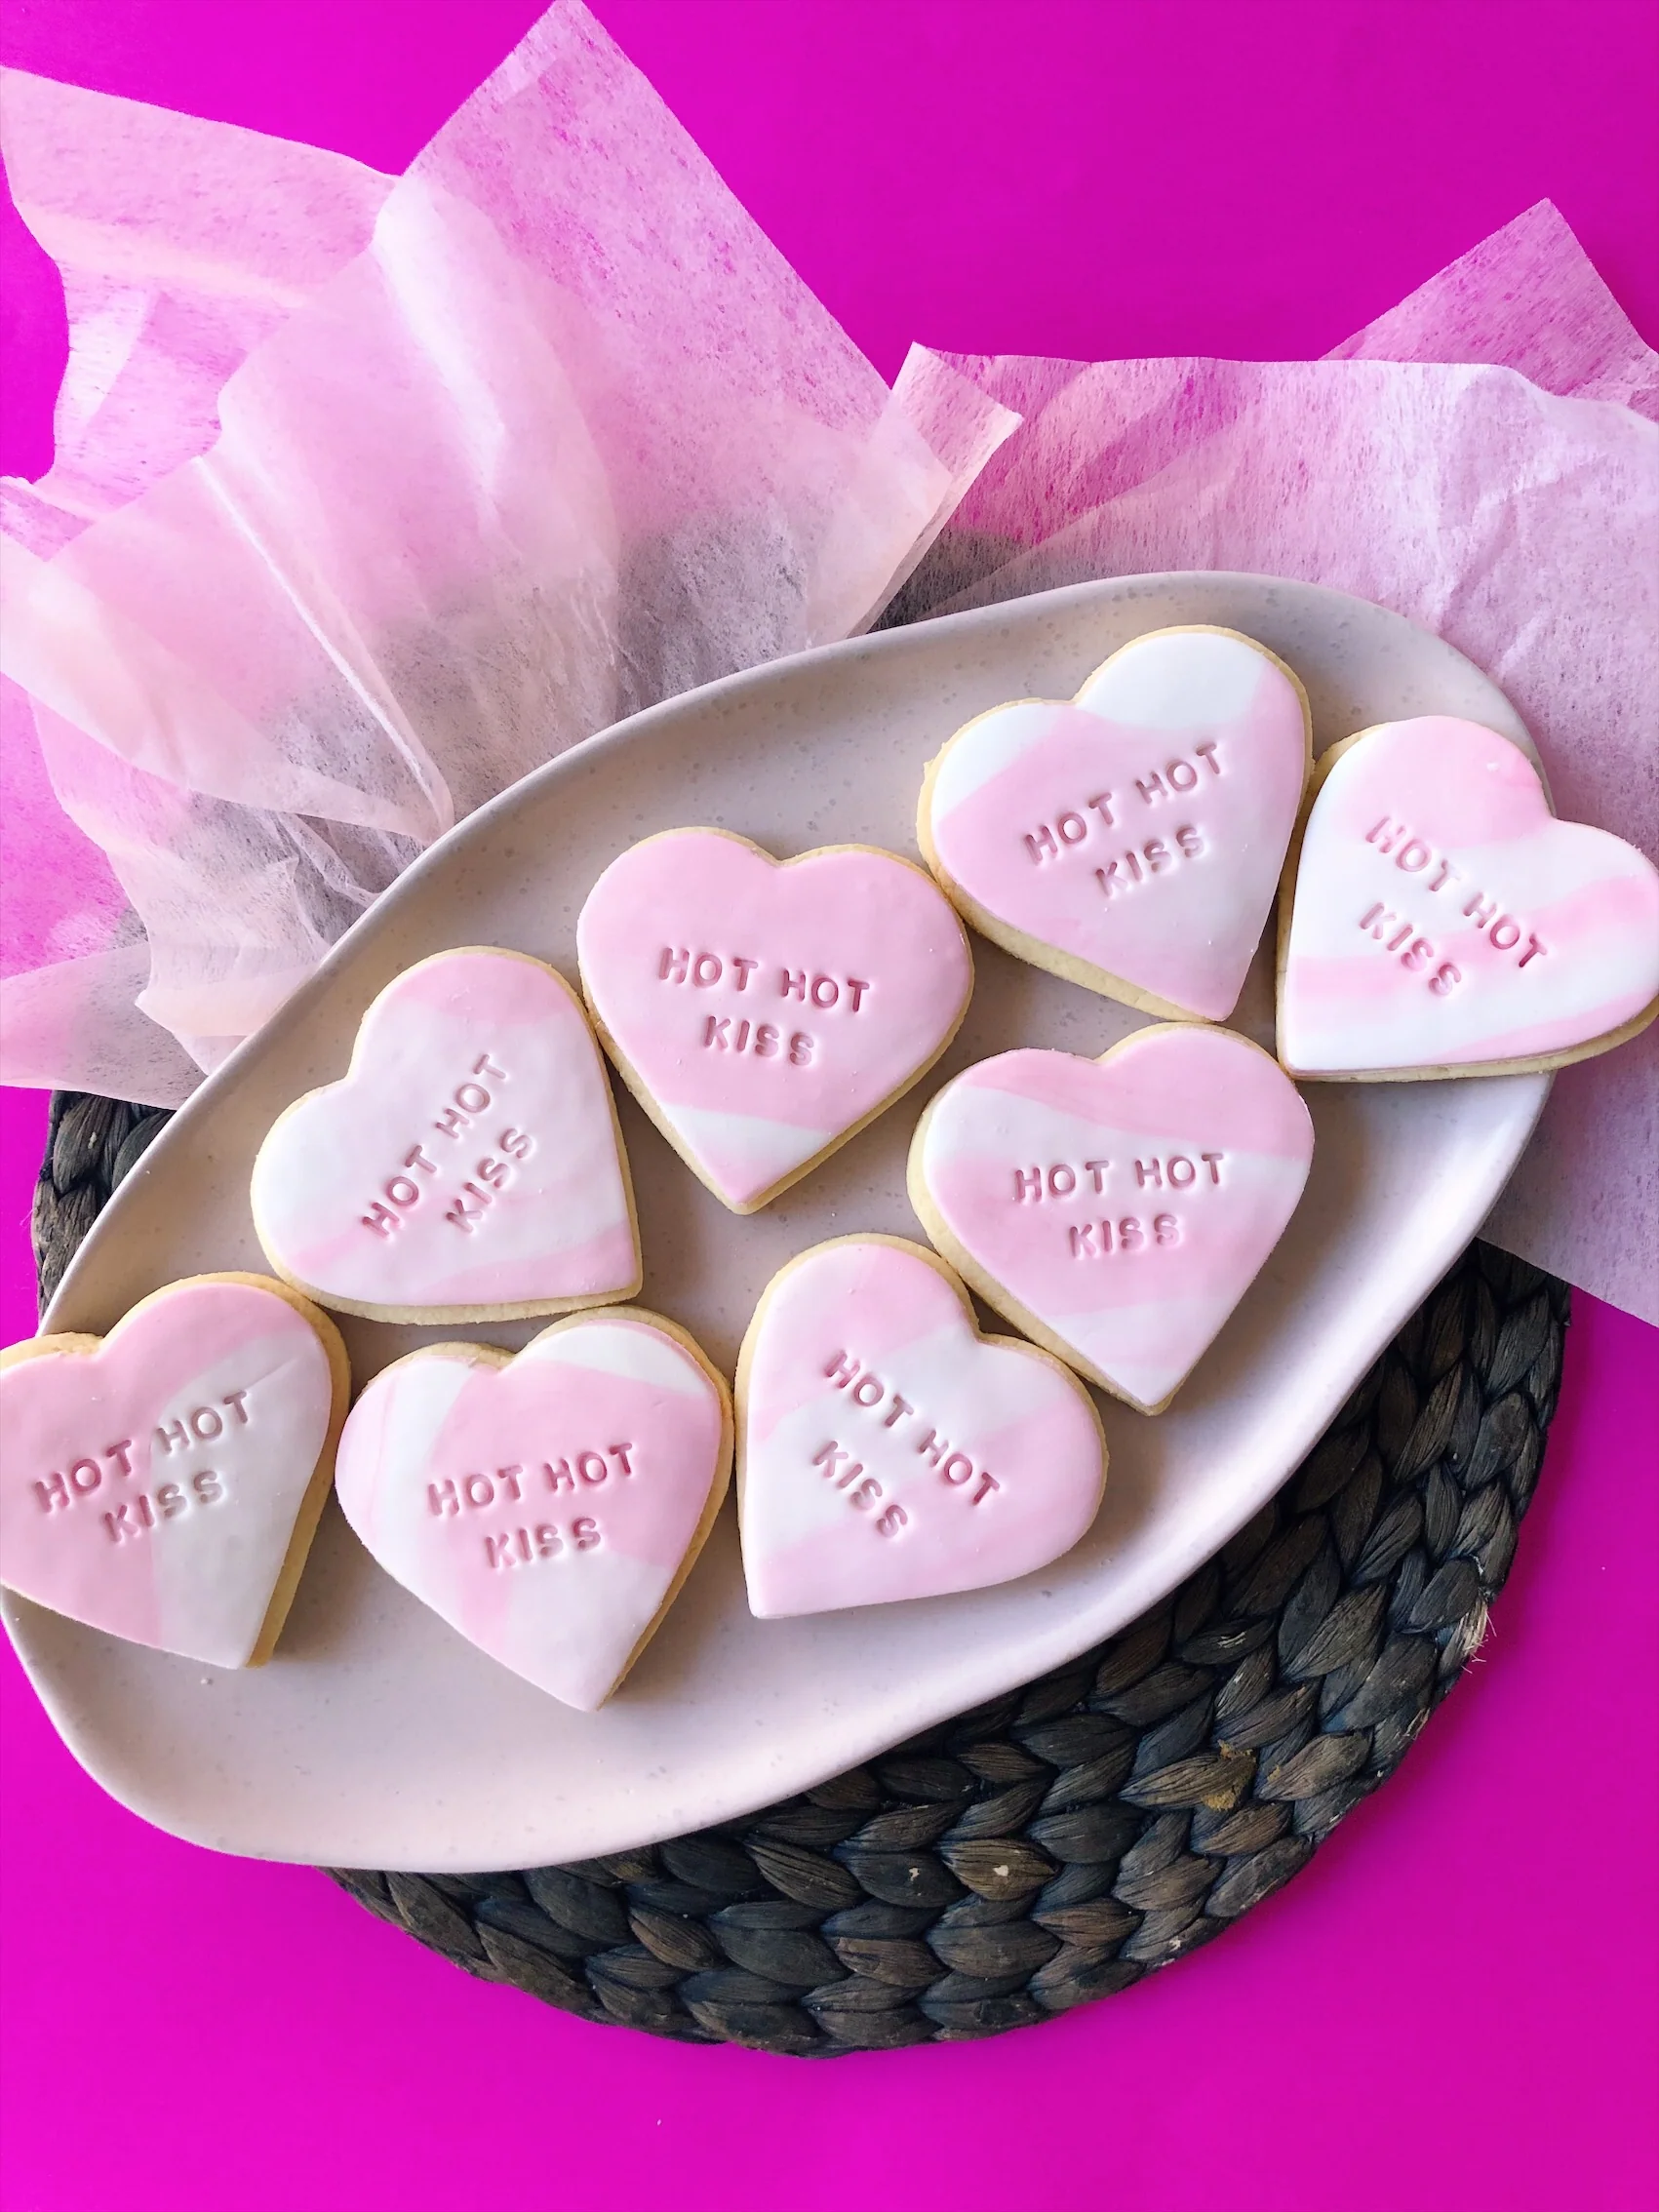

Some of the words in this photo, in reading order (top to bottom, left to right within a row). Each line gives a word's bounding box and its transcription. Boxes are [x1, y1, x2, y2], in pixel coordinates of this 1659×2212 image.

[1023, 791, 1116, 865] HOT
[1134, 742, 1227, 808] HOT
[1094, 824, 1209, 899] KISS
[1366, 815, 1462, 892] HOT
[1462, 891, 1549, 969] HOT
[658, 947, 759, 992] HOT
[780, 968, 870, 1013] HOT
[1359, 901, 1462, 997] KISS
[703, 1015, 815, 1066] KISS
[361, 1143, 440, 1239] HOT
[435, 1053, 508, 1140] HOT
[445, 1126, 536, 1234] KISS
[1013, 1160, 1111, 1204] HOT
[1133, 1152, 1224, 1190] HOT
[1069, 1214, 1181, 1260] KISS
[32, 1440, 137, 1514] HOT
[155, 1390, 252, 1454] HOT
[825, 1350, 915, 1429] HOT
[917, 1428, 1002, 1507] HOT
[103, 1470, 226, 1544] KISS
[427, 1465, 525, 1517] HOT
[542, 1442, 637, 1491] HOT
[812, 1441, 909, 1538] KISS
[486, 1517, 603, 1569] KISS
